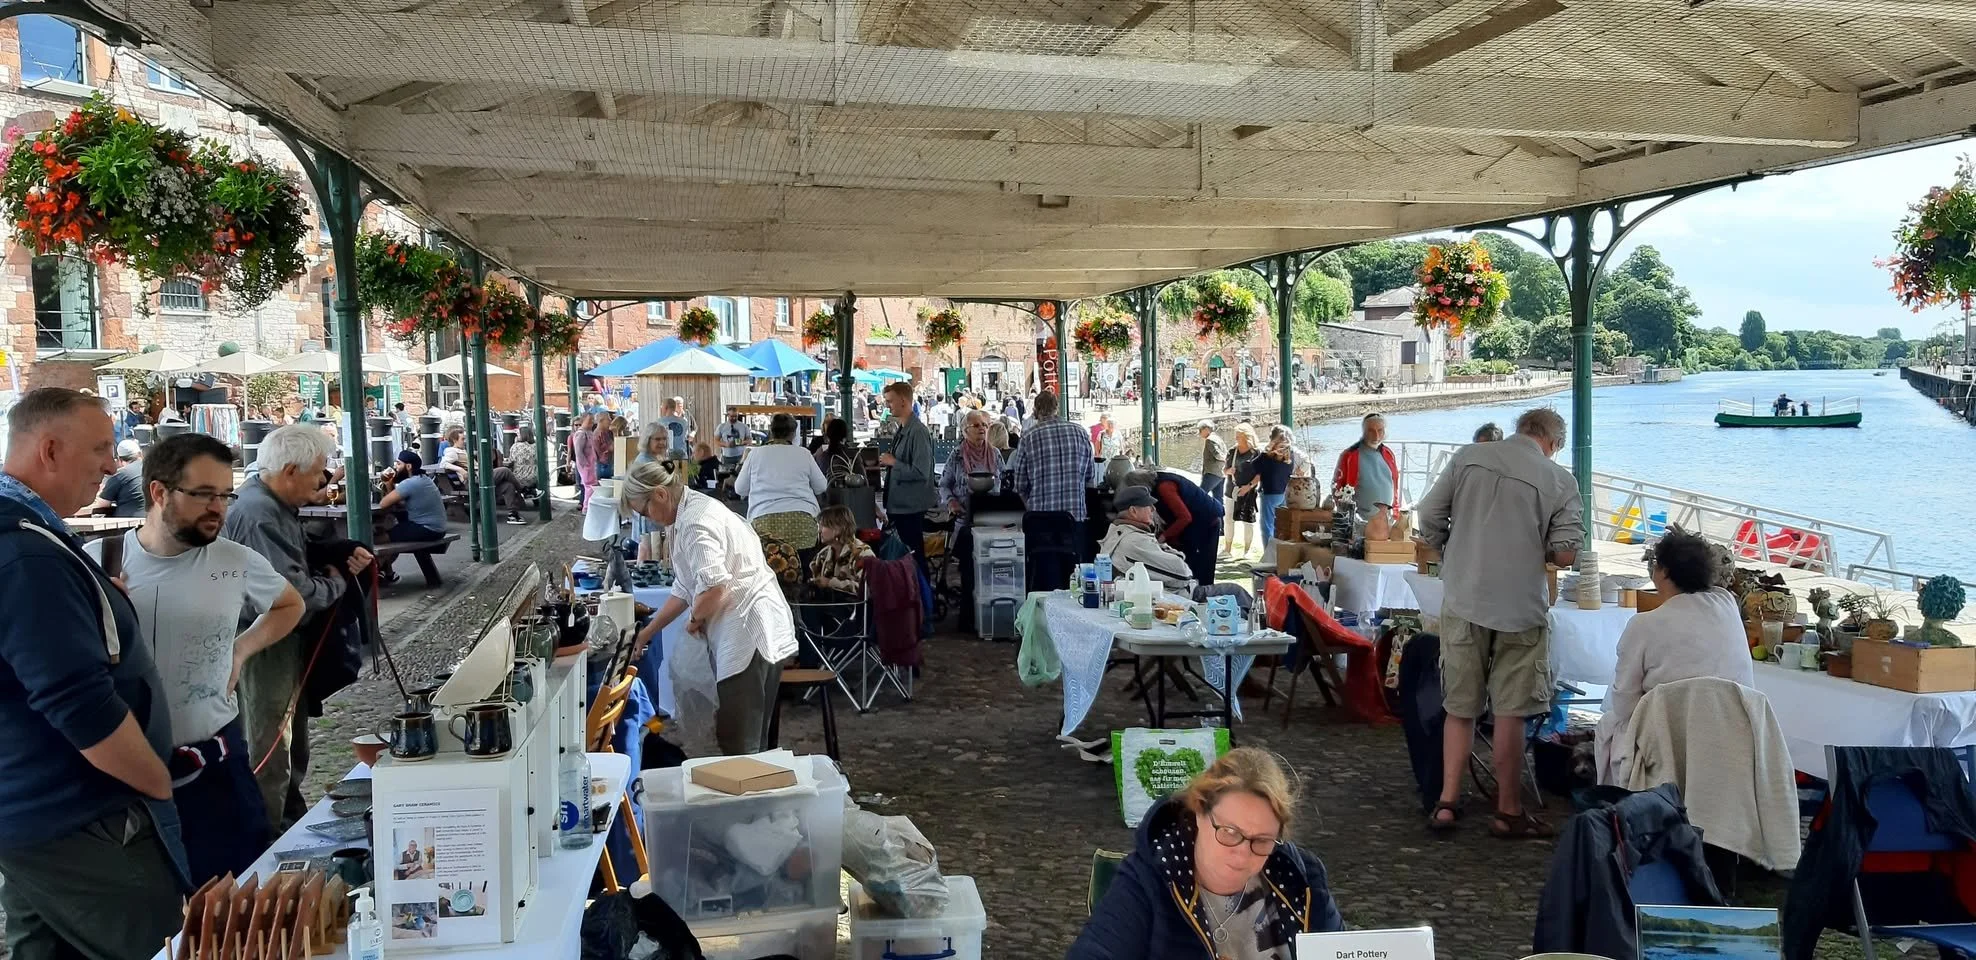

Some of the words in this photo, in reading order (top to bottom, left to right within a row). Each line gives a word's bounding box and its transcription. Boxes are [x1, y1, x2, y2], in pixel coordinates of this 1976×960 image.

[108, 386, 116, 397] P
[1336, 950, 1355, 959] Dart
[1356, 950, 1388, 959] Pottery
